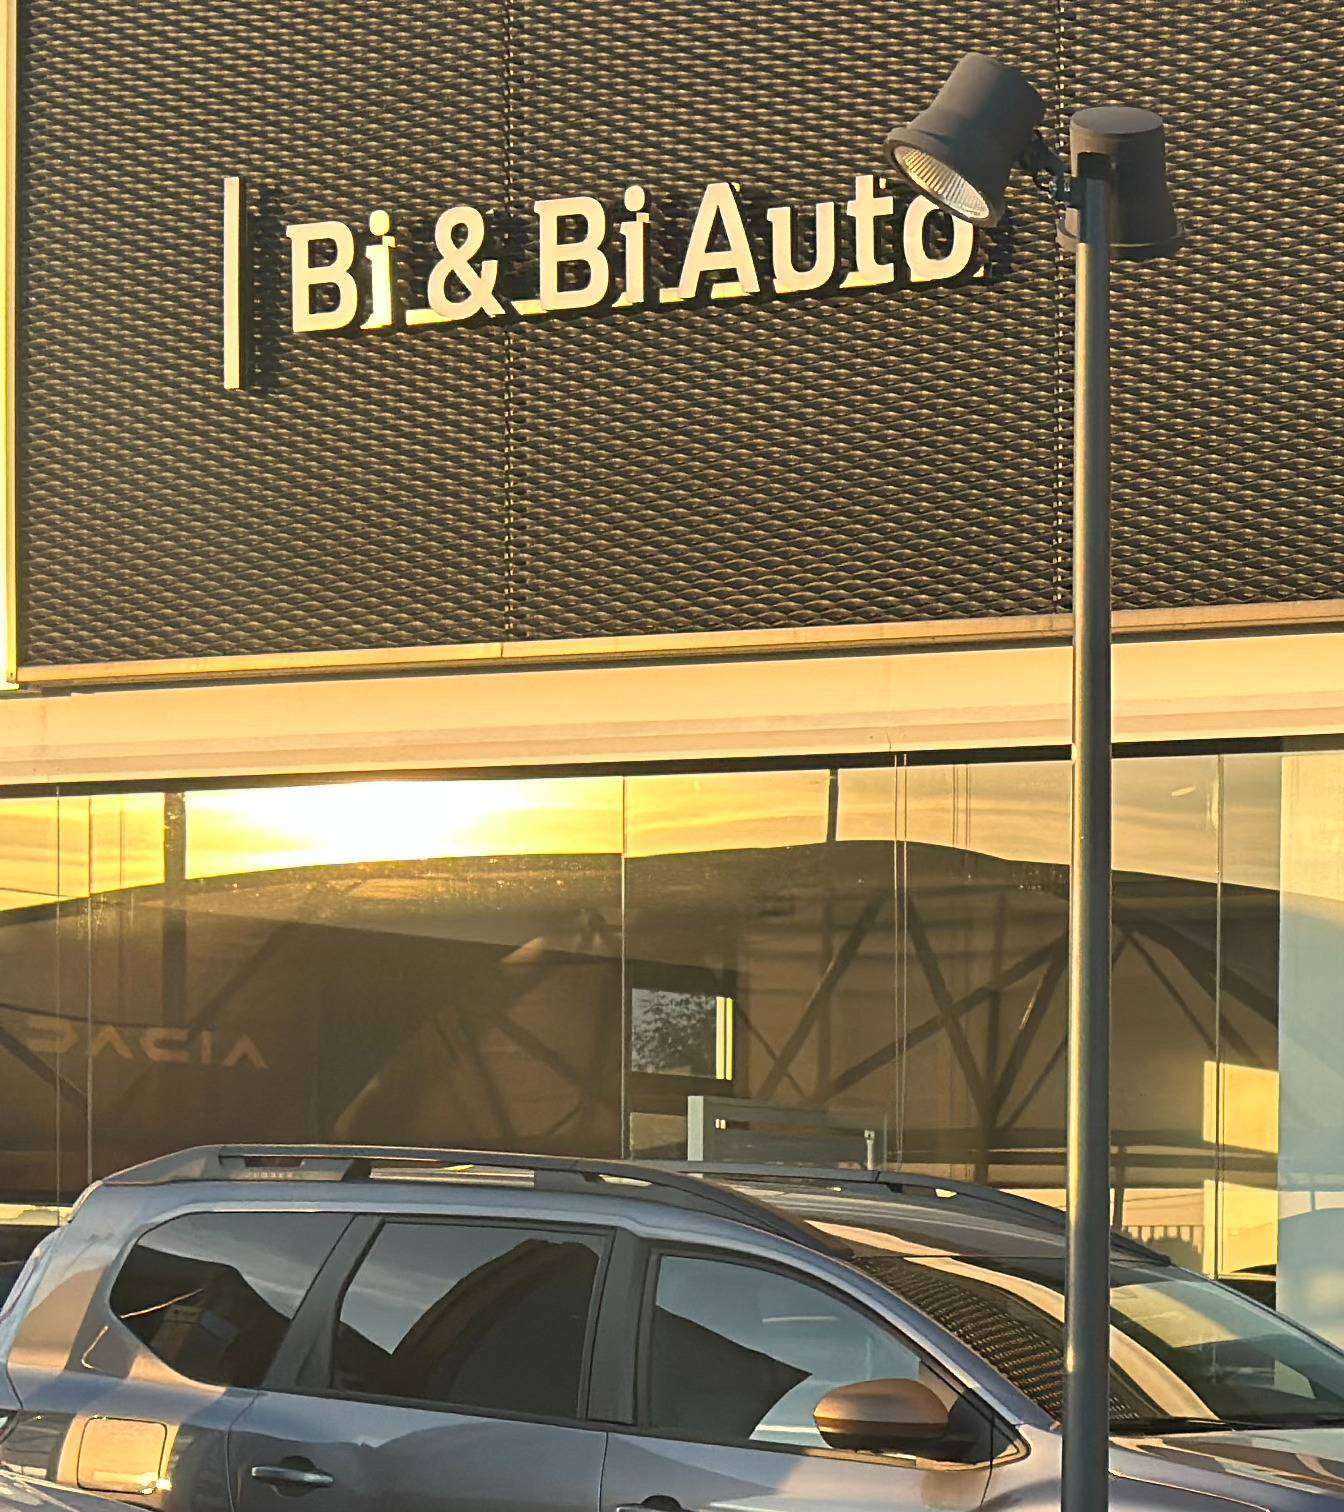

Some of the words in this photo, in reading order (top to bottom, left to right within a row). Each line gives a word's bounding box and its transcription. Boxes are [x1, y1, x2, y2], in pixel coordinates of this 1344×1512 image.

[286, 210, 396, 334] Bi
[428, 206, 506, 319] &
[534, 184, 650, 313] Bi
[679, 174, 978, 300] Auto
